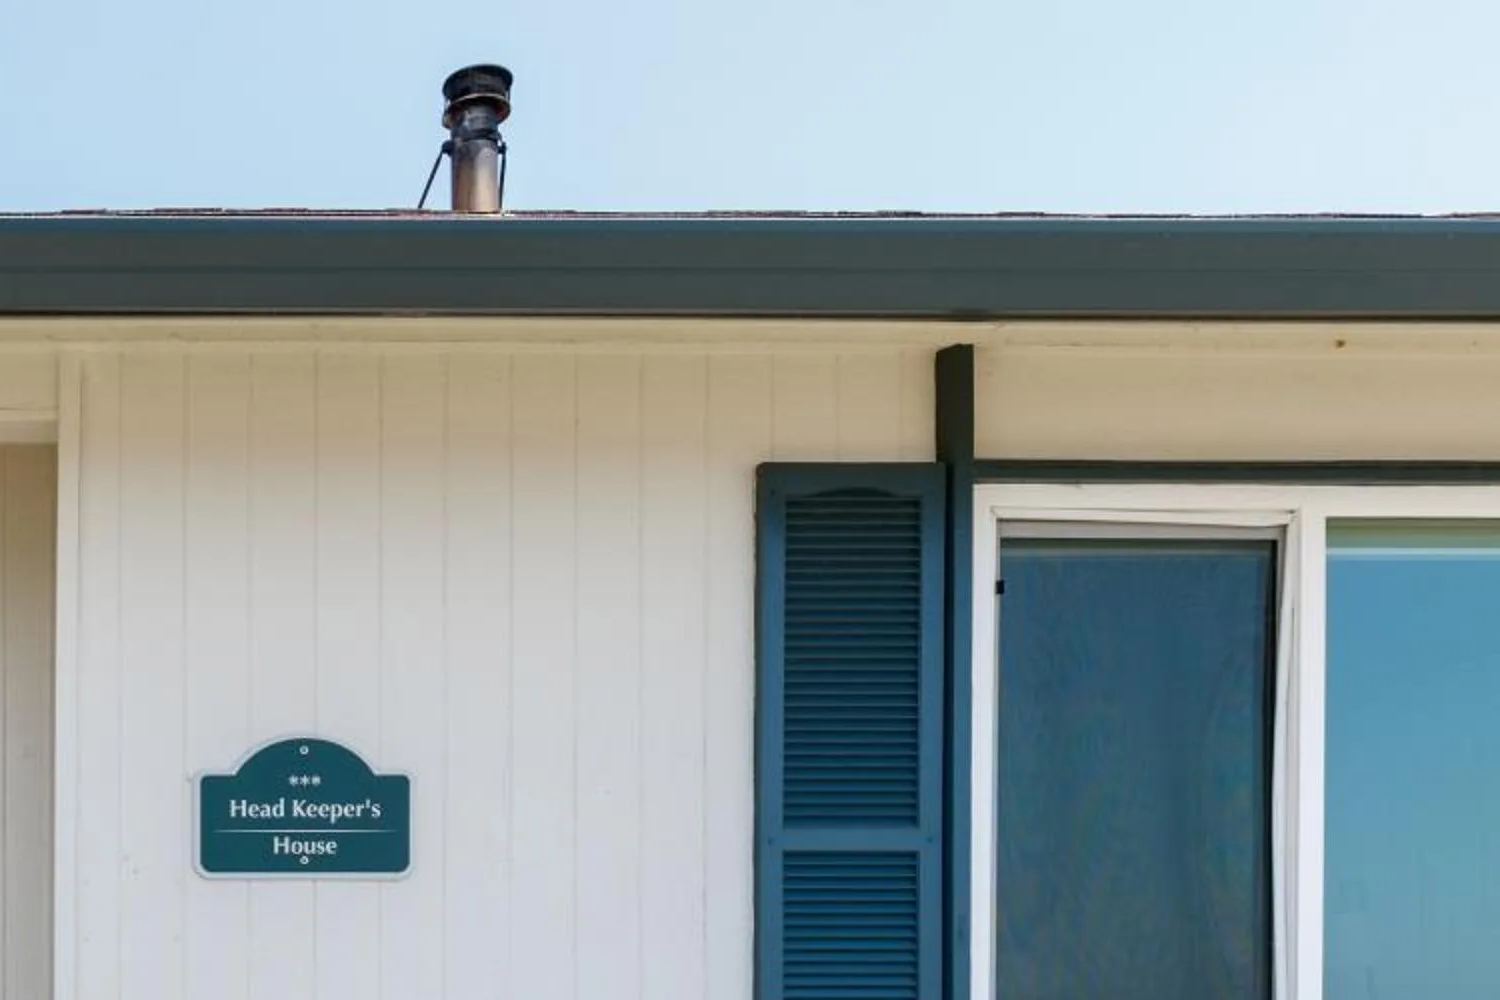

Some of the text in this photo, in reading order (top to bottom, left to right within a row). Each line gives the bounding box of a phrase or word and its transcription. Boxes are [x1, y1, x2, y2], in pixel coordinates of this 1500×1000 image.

[229, 797, 382, 824] Head Keeper's
[272, 836, 338, 855] House
